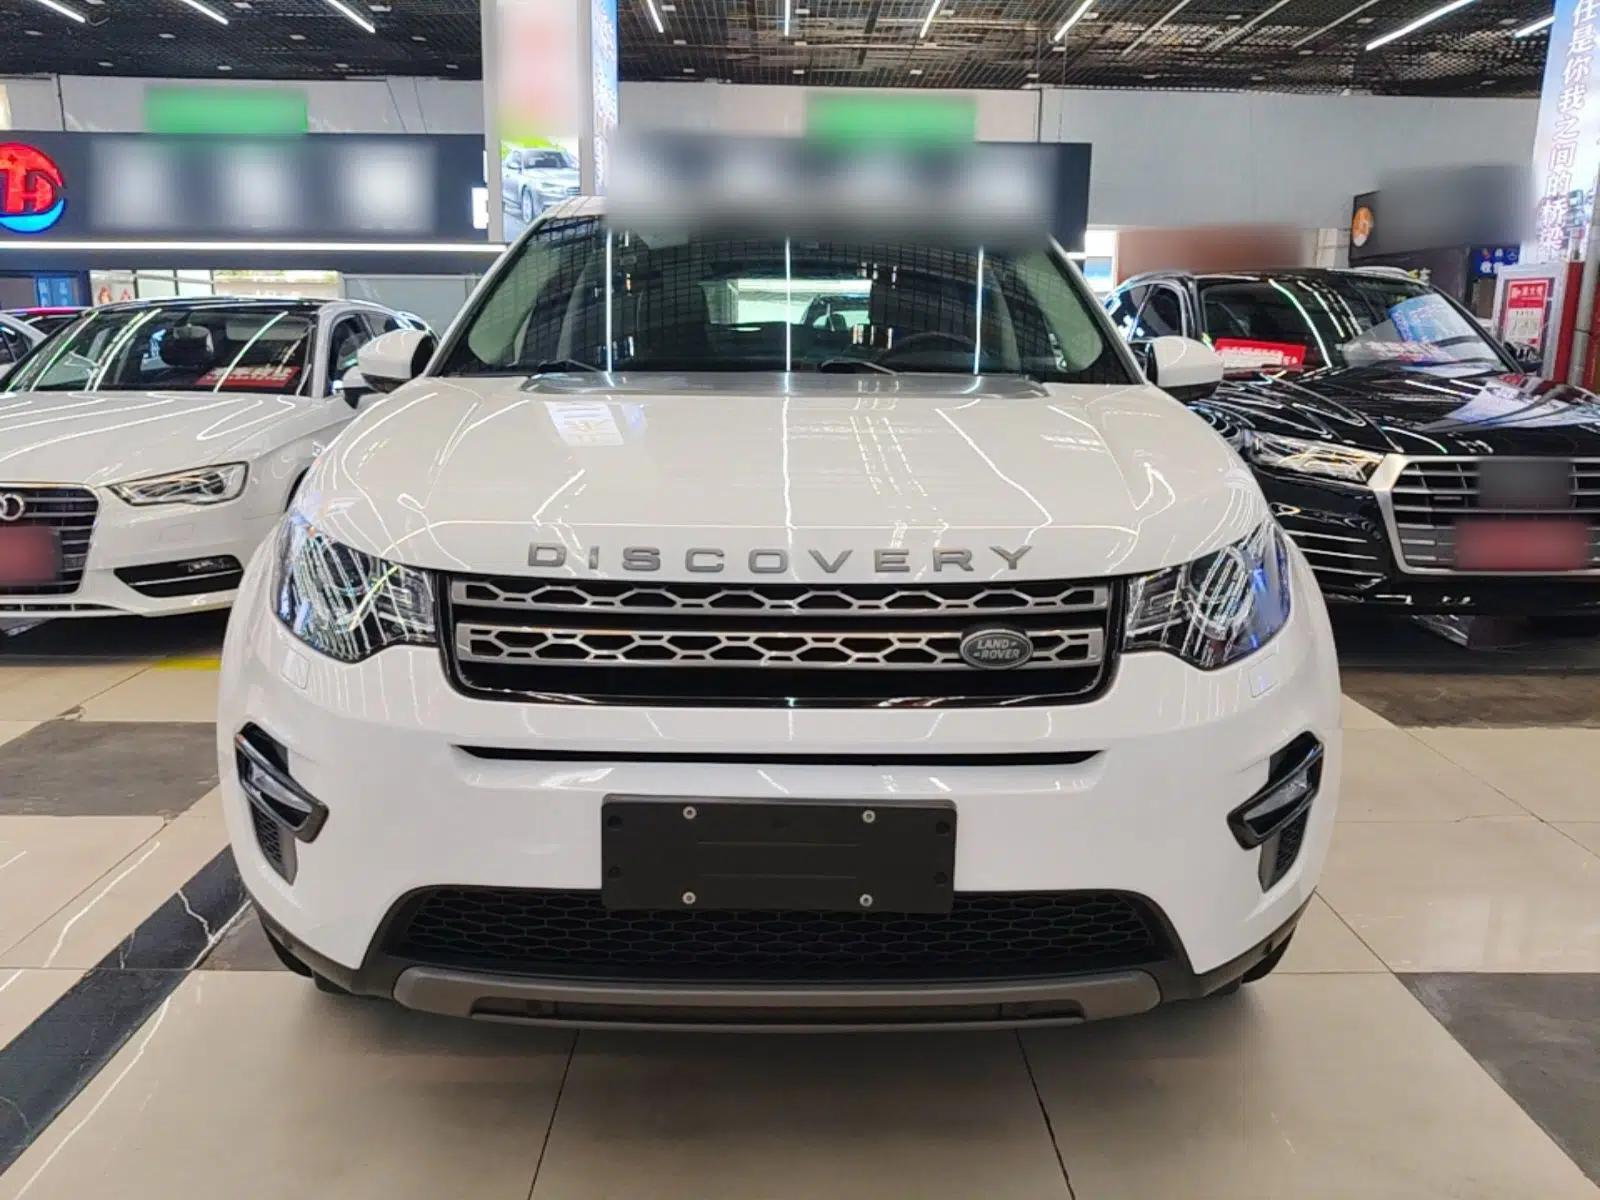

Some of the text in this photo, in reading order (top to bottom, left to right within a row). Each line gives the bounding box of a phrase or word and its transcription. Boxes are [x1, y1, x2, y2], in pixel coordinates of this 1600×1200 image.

[527, 542, 1033, 574] DISCOVERY
[977, 639, 1010, 650] LAND
[981, 648, 1020, 660] ROVER
